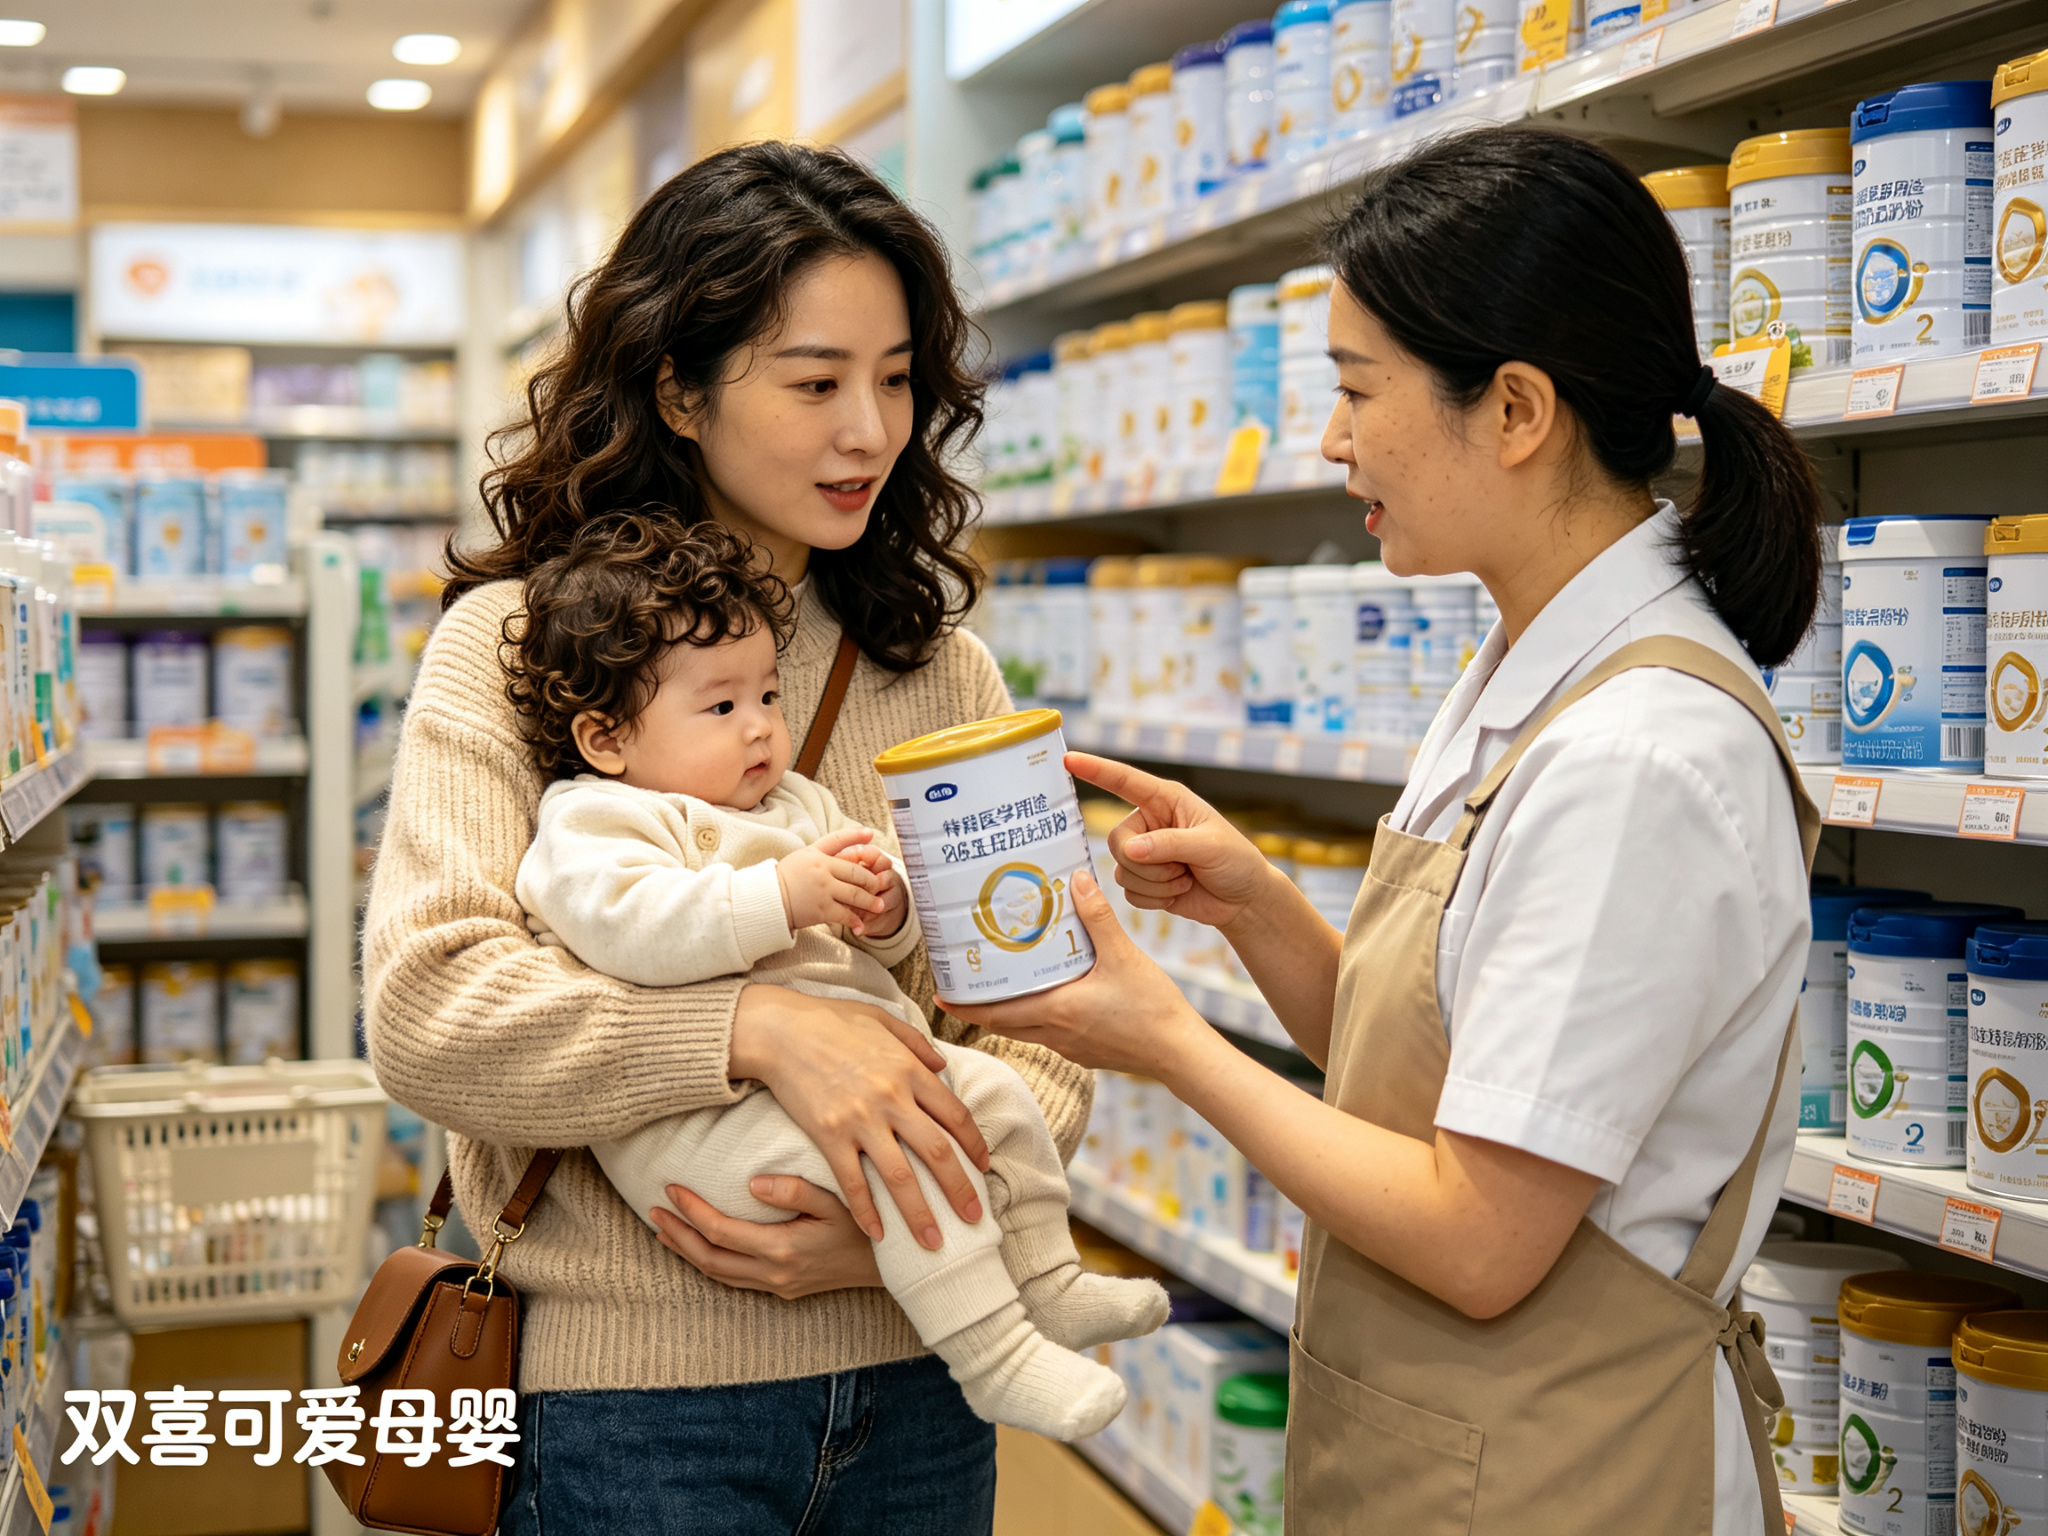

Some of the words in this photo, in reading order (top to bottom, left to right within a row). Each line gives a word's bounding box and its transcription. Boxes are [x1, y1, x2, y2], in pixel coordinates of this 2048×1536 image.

[1916, 313, 1933, 342] 2
[1066, 929, 1083, 957] 1
[1905, 1122, 1924, 1146] 2
[1886, 1487, 1904, 1513] 2
